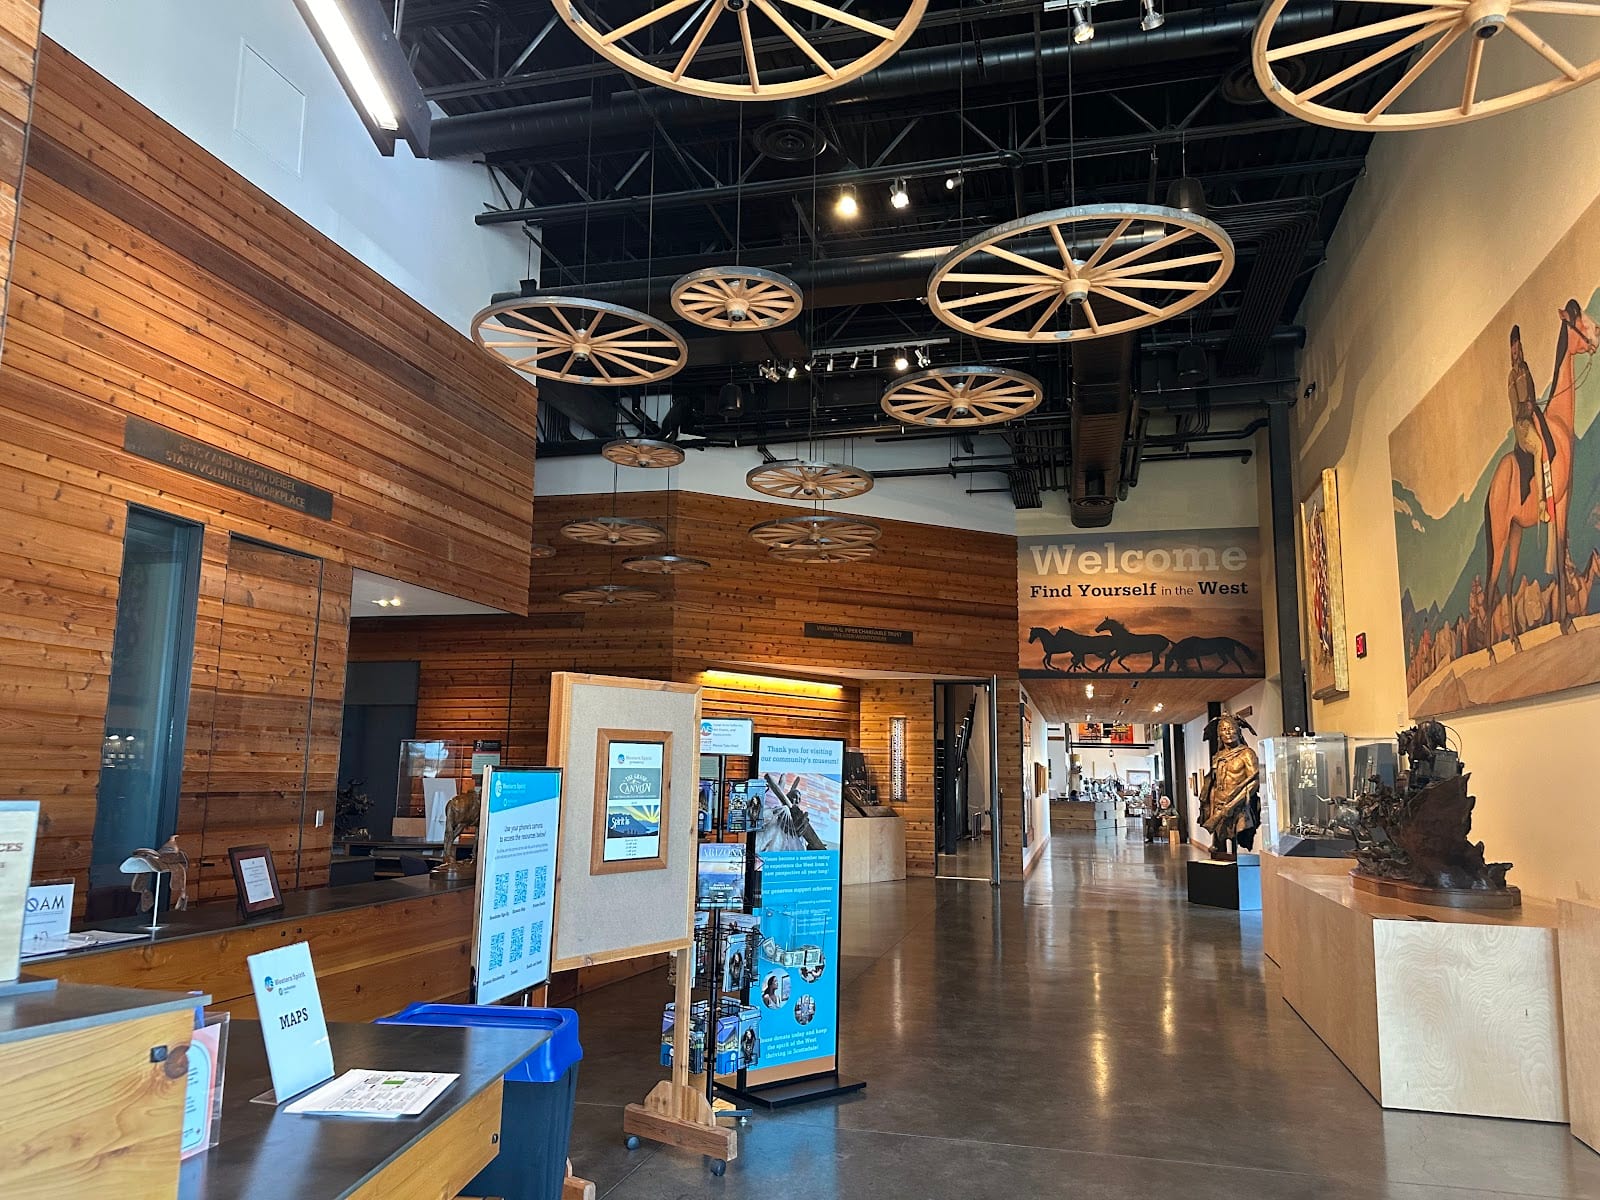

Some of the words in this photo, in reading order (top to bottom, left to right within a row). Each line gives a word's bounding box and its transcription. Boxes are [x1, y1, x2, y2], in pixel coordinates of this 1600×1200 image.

[254, 482, 305, 508] WORKPLACE
[1029, 542, 1248, 576] Welcome
[1030, 584, 1072, 598] Find
[1077, 582, 1157, 597] Yourself
[1160, 586, 1172, 596] in
[1175, 585, 1194, 596] the
[1198, 582, 1249, 596] West
[810, 748, 833, 756] visiting
[772, 756, 812, 765] community's
[620, 782, 652, 794] CANYON
[610, 816, 624, 830] Spirit
[704, 848, 743, 858] ARIZONA
[770, 887, 794, 895] generous
[794, 886, 812, 894] support
[279, 1007, 309, 1030] MAPS
[766, 1050, 786, 1059] thriving
[792, 1044, 818, 1054] Scottsdale!
[776, 1041, 790, 1050] spirit
